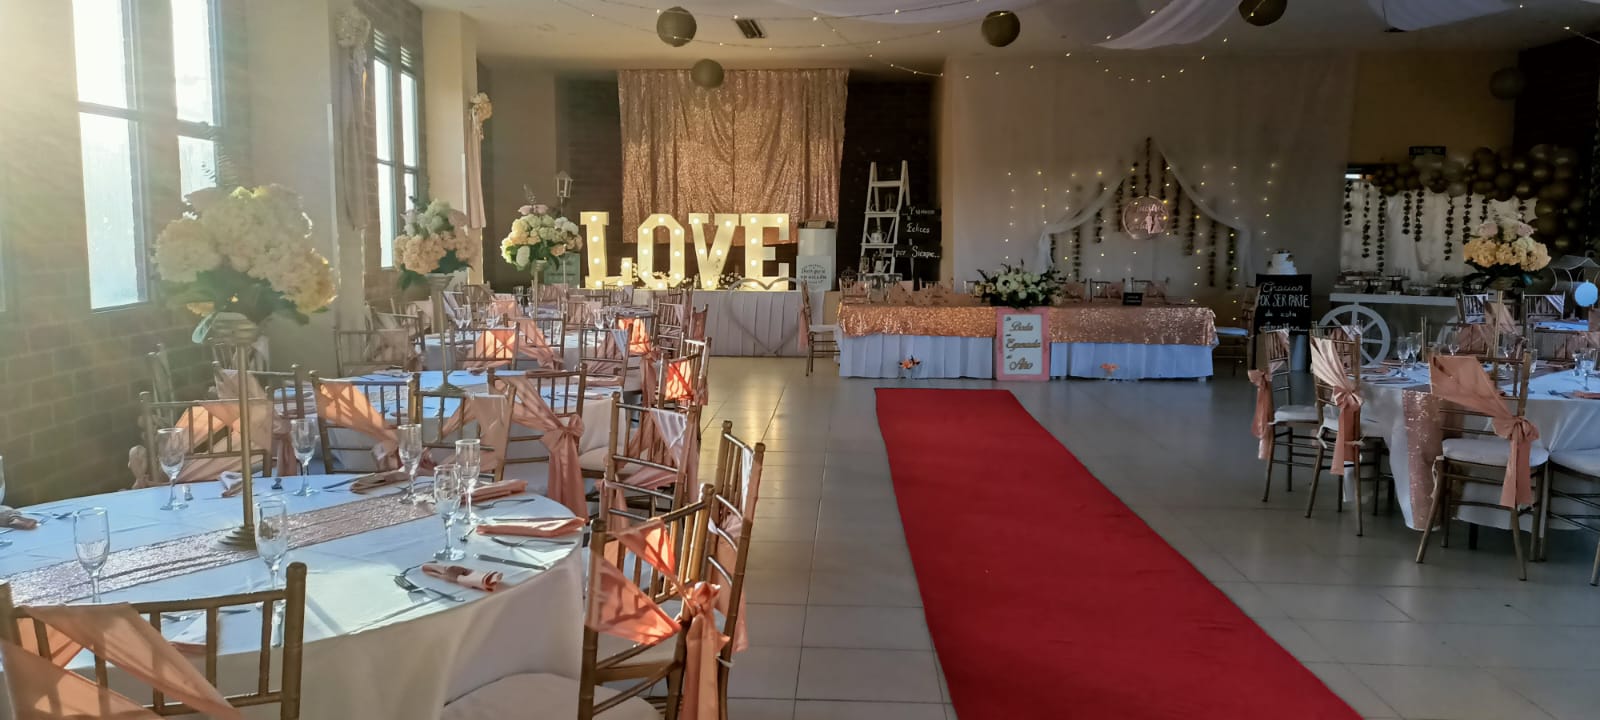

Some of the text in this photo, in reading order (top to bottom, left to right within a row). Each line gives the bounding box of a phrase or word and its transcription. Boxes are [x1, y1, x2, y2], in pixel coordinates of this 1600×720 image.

[580, 211, 789, 291] LOVE
[1263, 282, 1303, 293] Gracias
[1272, 294, 1287, 308] SER
[1288, 294, 1310, 308] PARTE
